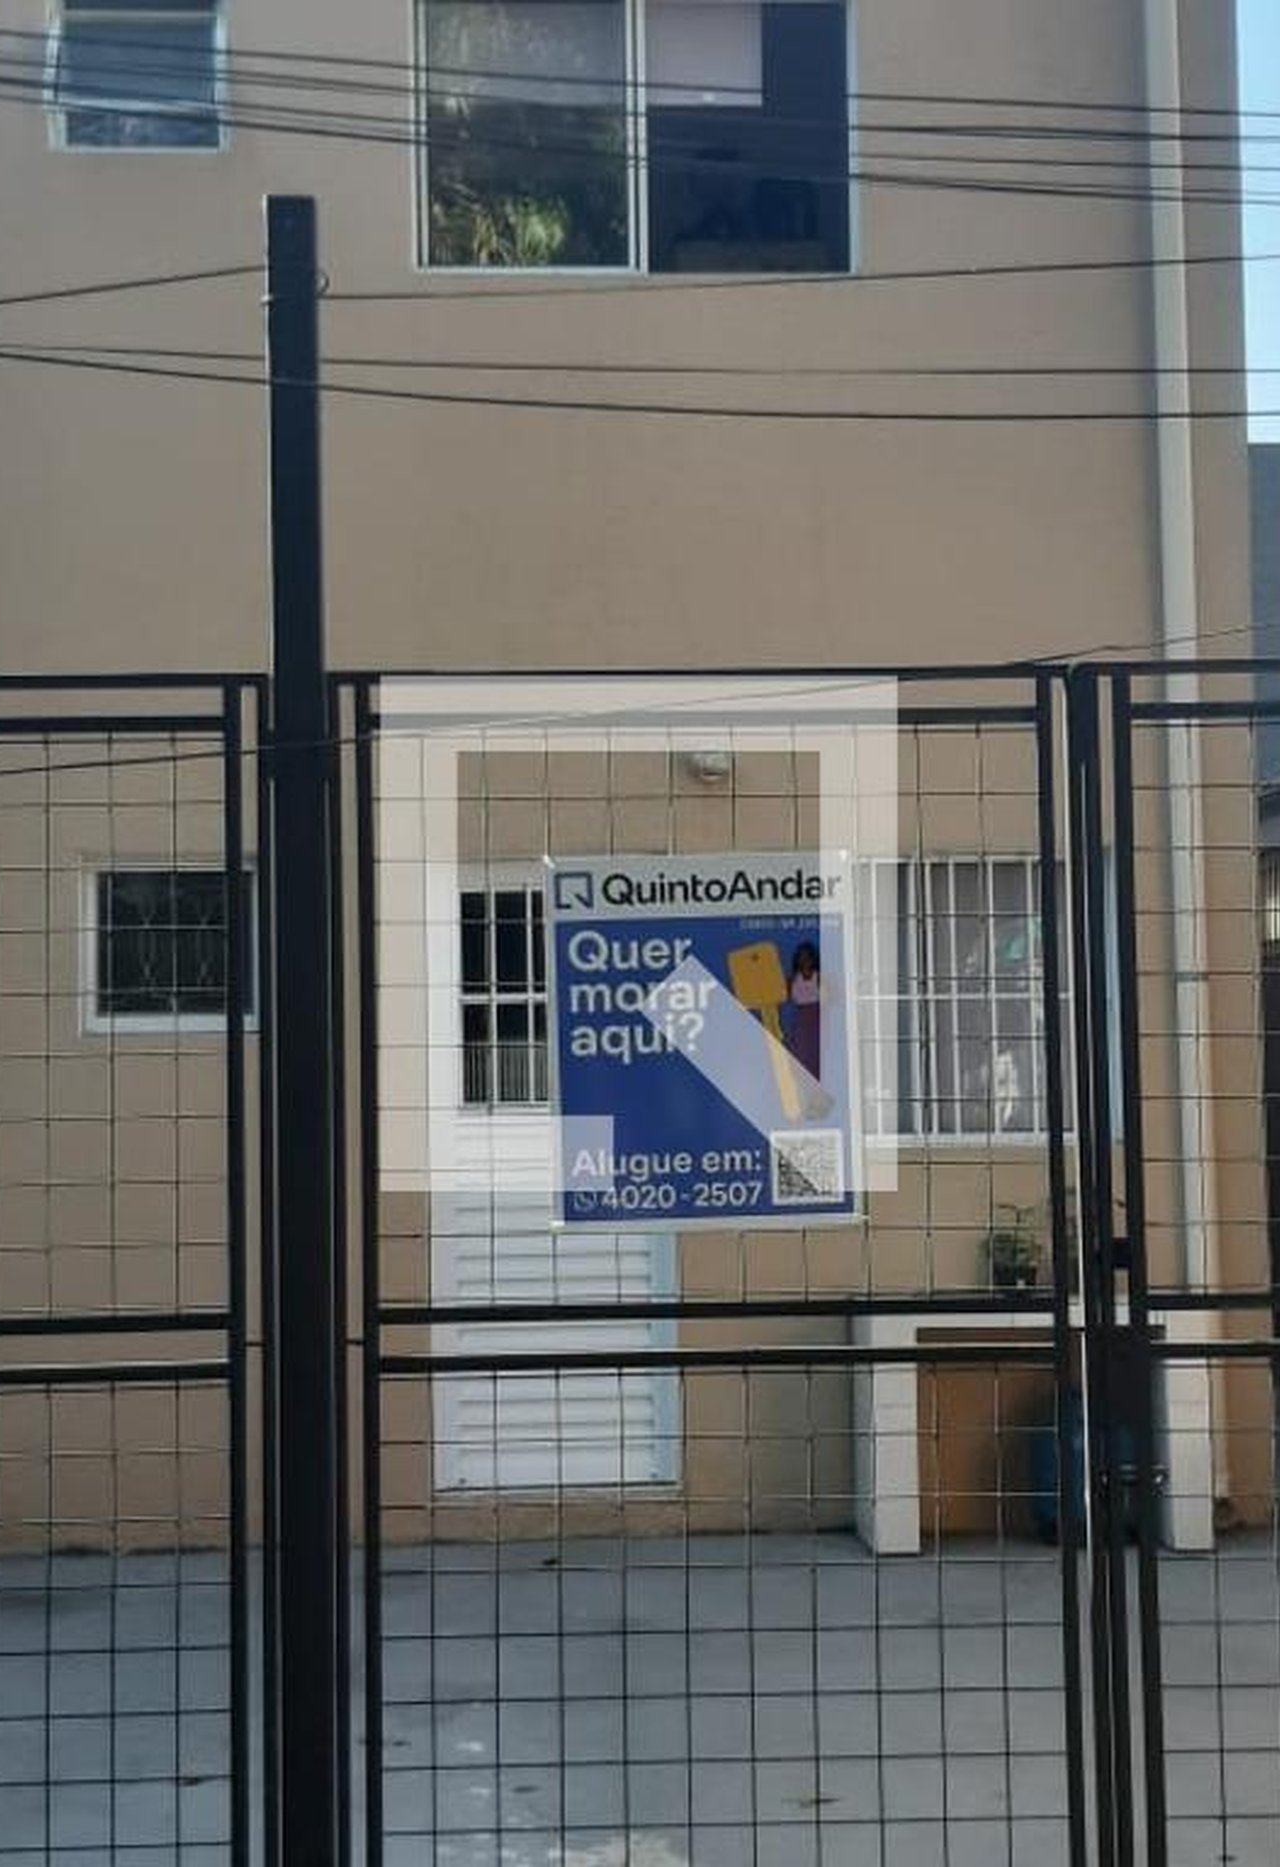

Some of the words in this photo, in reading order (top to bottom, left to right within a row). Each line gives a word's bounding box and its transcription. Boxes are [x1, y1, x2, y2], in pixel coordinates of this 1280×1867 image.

[602, 870, 841, 907] QuintoAndar
[568, 930, 692, 972] Quer
[570, 979, 718, 1014] morar
[570, 1011, 705, 1064] aqui?
[572, 1149, 693, 1182] Alugue
[702, 1149, 761, 1174] em:
